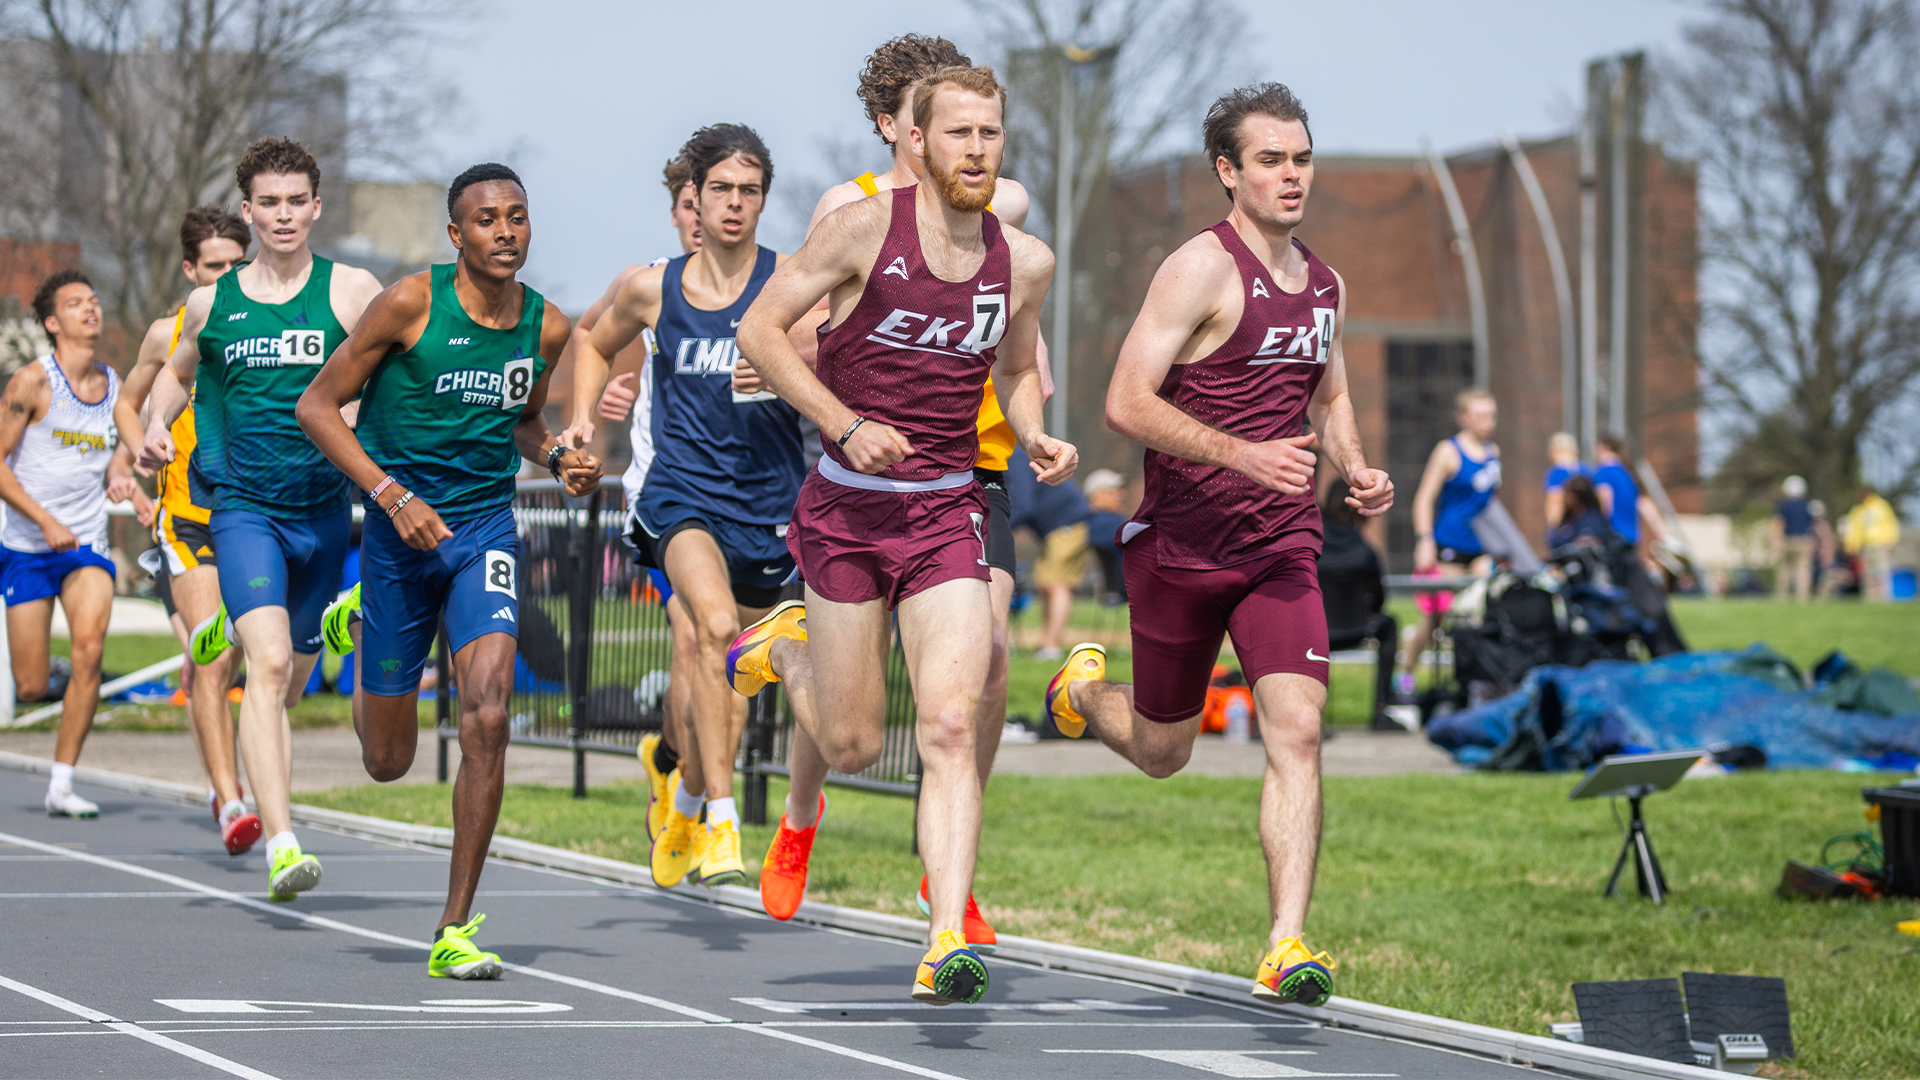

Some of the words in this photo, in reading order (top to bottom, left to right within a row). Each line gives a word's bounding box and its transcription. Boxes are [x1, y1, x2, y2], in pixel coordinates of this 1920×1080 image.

[228, 311, 248, 322] NEC
[976, 302, 1000, 342] 7
[285, 334, 321, 356] 16
[448, 337, 471, 346] NEC
[1254, 326, 1318, 357] EK
[1321, 313, 1330, 359] 4
[224, 337, 283, 366] CHICA
[246, 356, 284, 368] STATE
[674, 337, 741, 378] LMU
[434, 370, 504, 394] CHICA
[508, 366, 529, 401] 8
[461, 391, 501, 406] STATE
[489, 559, 512, 591] 8
